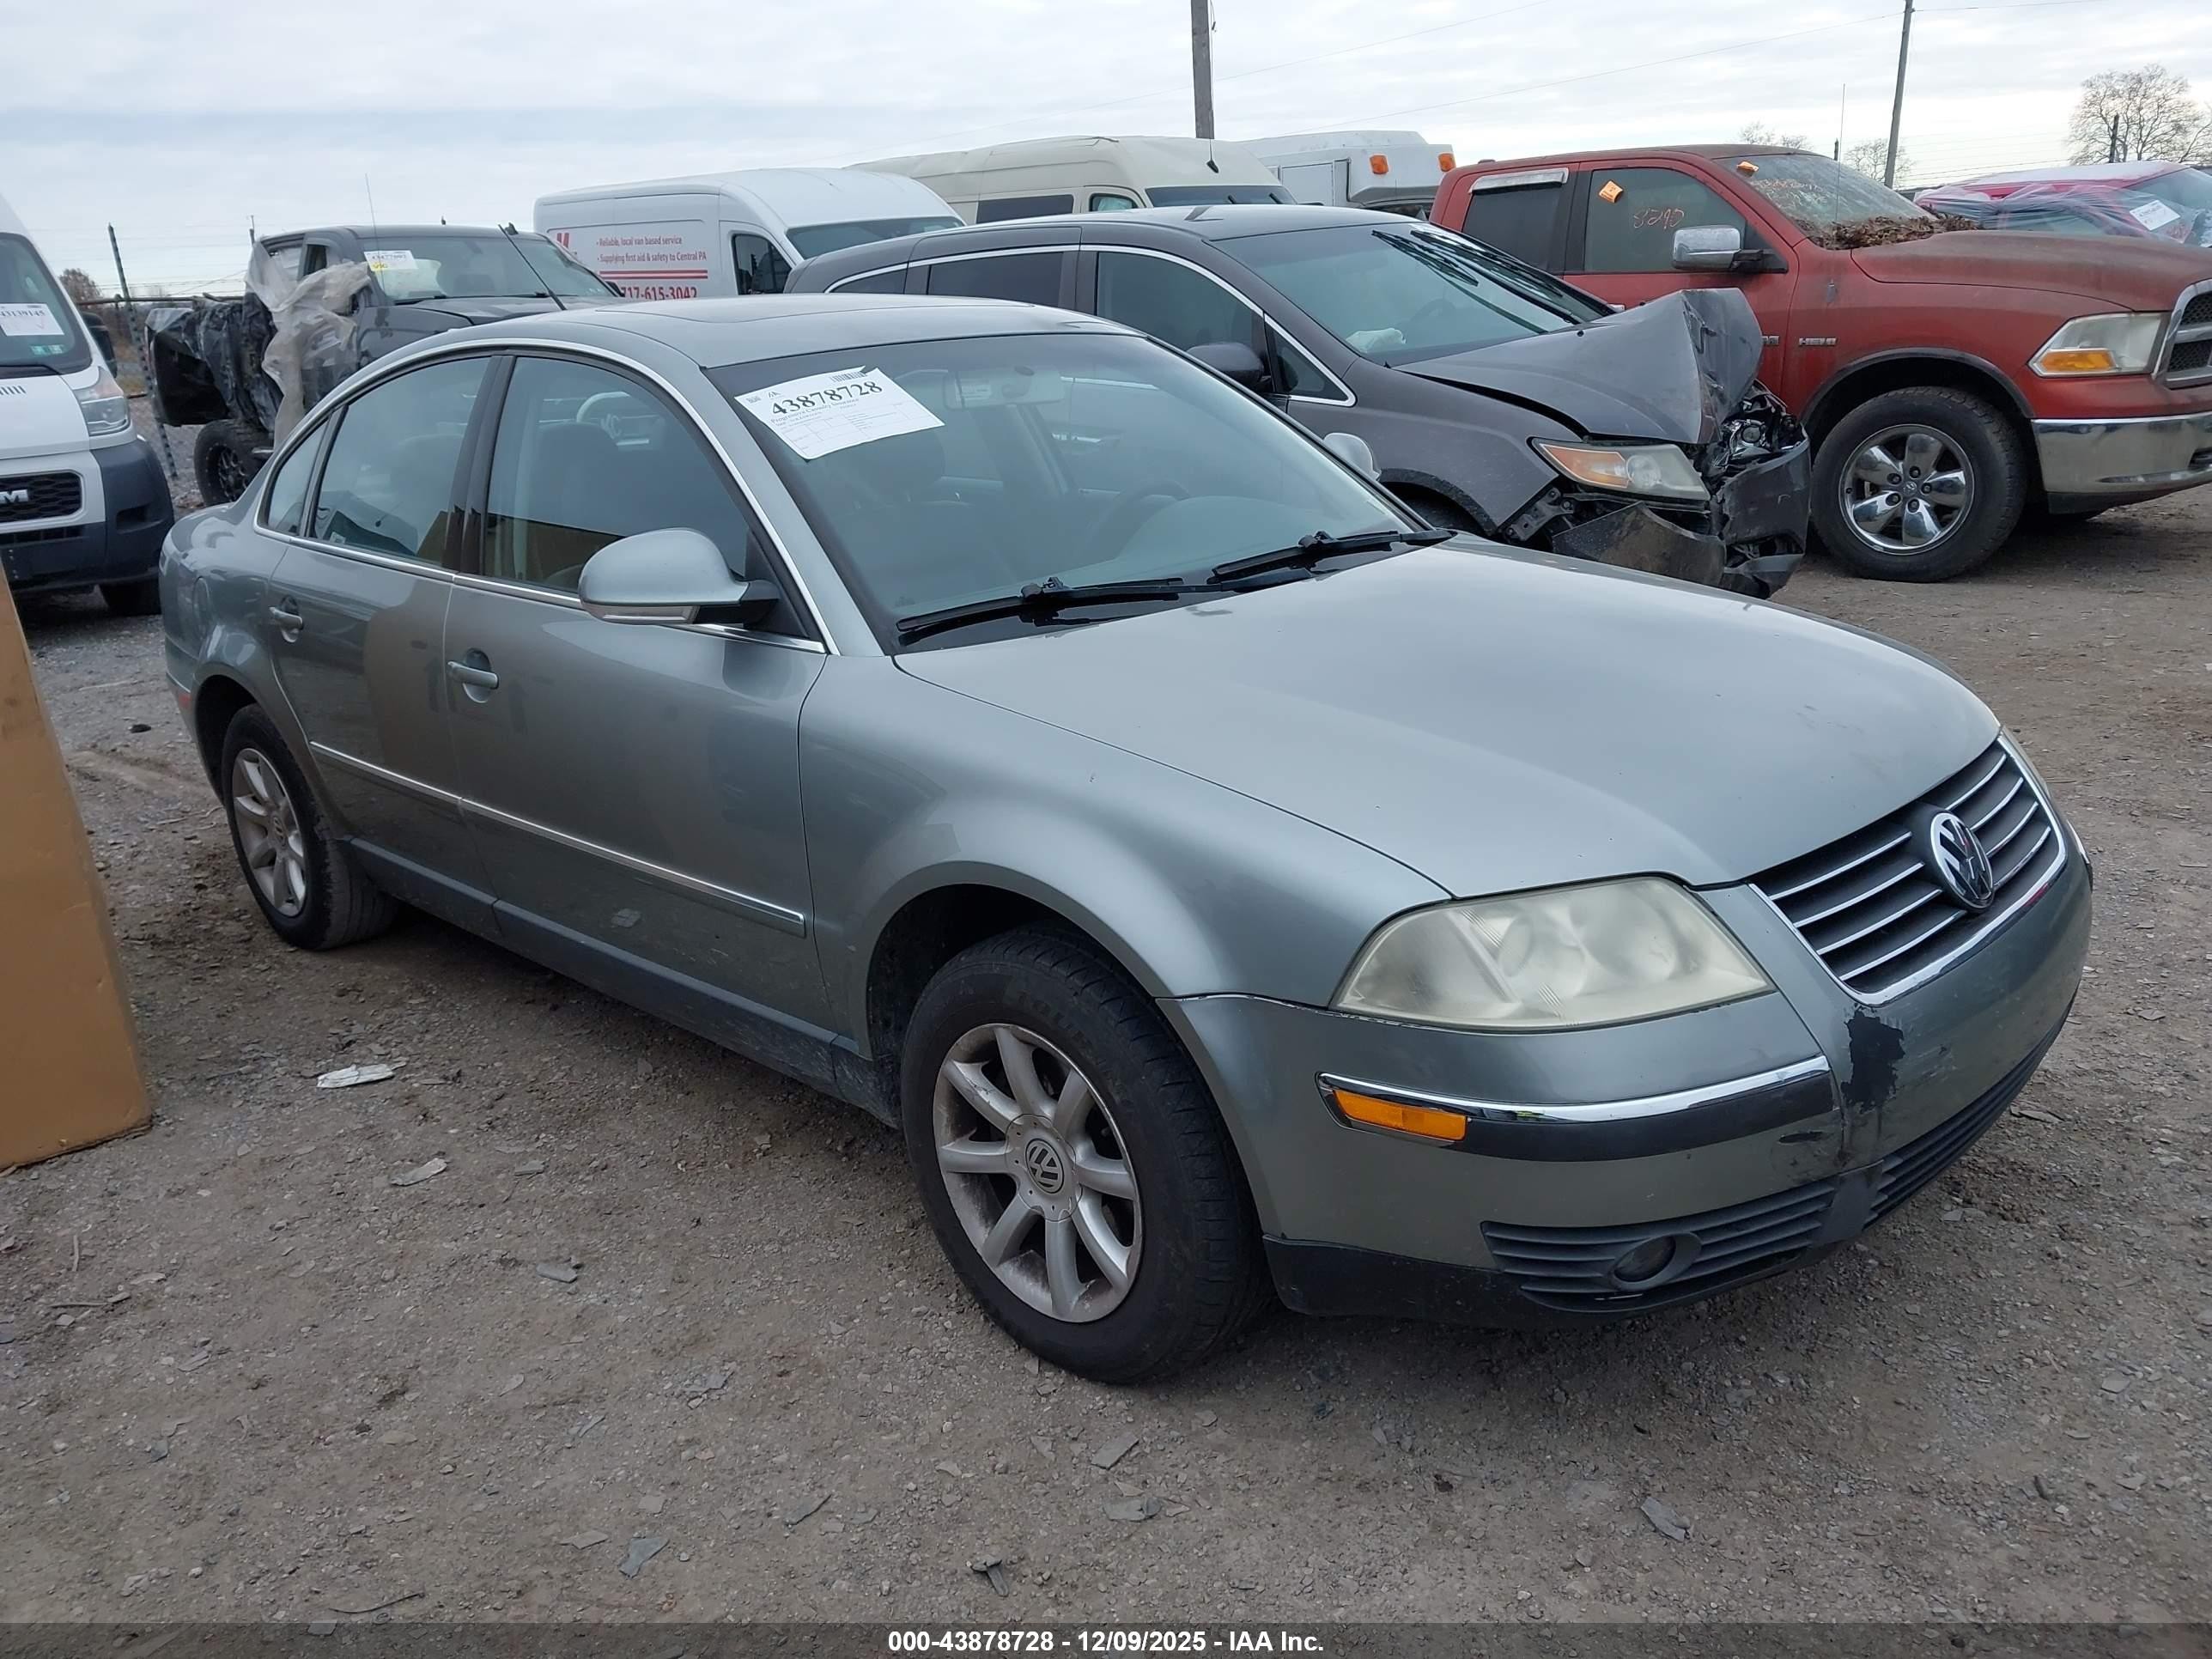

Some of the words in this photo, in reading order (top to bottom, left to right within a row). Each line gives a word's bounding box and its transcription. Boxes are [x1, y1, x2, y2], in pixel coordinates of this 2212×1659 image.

[621, 236, 634, 246] local
[645, 236, 660, 246] based
[662, 235, 683, 245] service
[600, 253, 625, 264] Supplying
[626, 252, 636, 262] first
[652, 252, 668, 264] safety
[677, 251, 697, 261] Central
[698, 250, 708, 261] PA
[772, 380, 883, 416] 43878728
